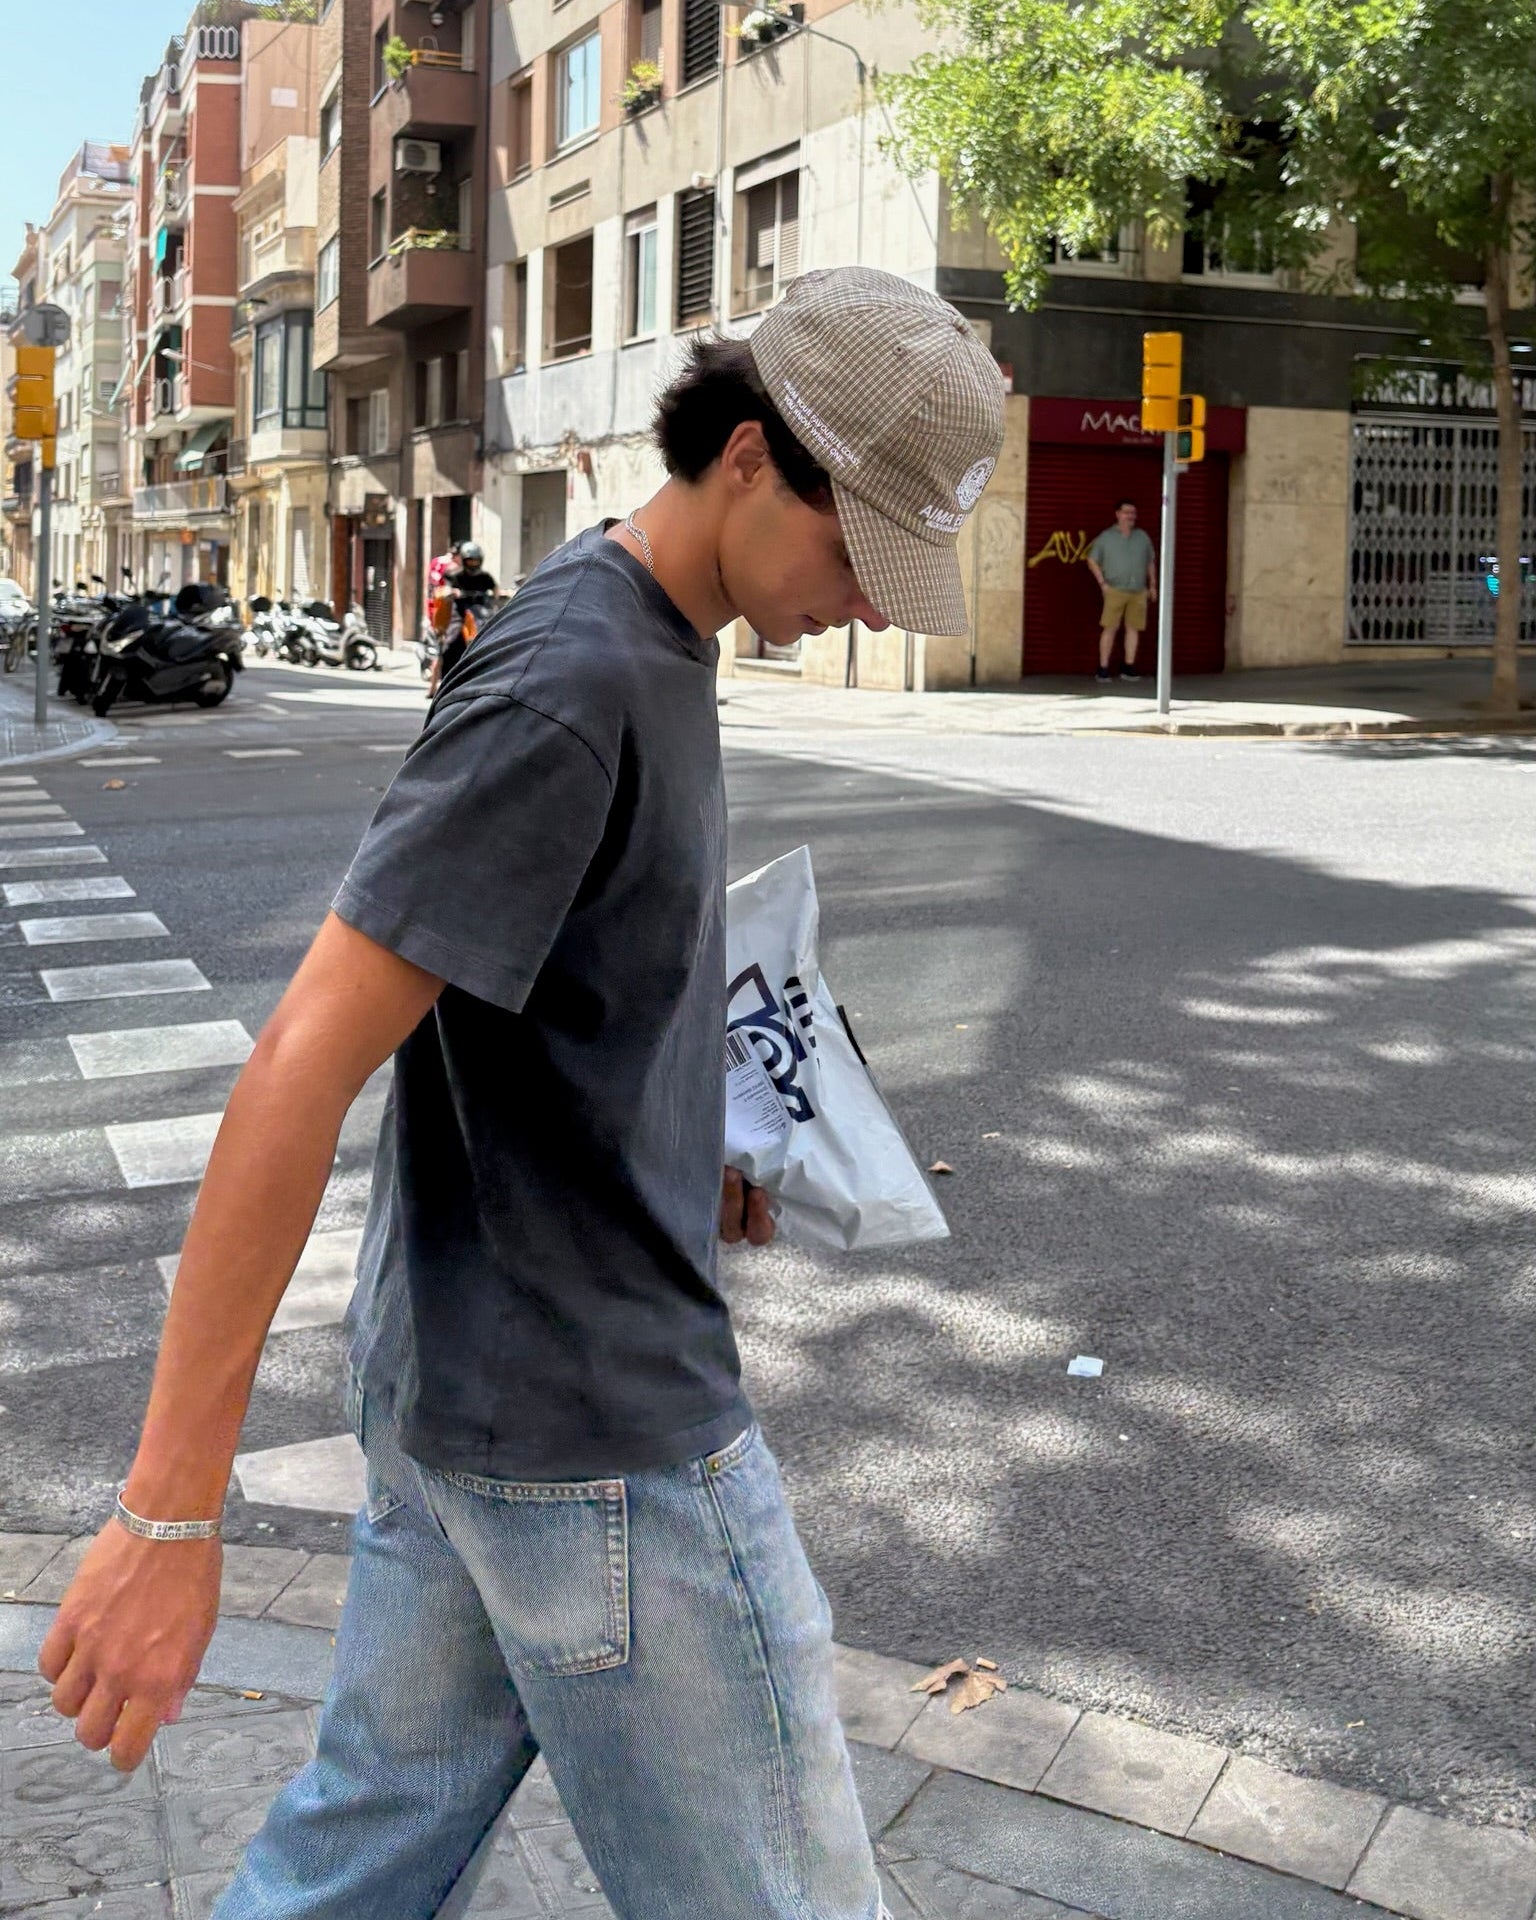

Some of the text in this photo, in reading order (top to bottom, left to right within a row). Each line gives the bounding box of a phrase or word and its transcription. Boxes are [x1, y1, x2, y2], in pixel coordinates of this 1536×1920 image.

[783, 393, 796, 411] YOU
[793, 408, 813, 430] KNOW
[811, 427, 833, 449] WHICH
[796, 397, 813, 417] YOUR
[810, 414, 844, 450] FAVOURITE
[918, 505, 955, 526] AIMA
